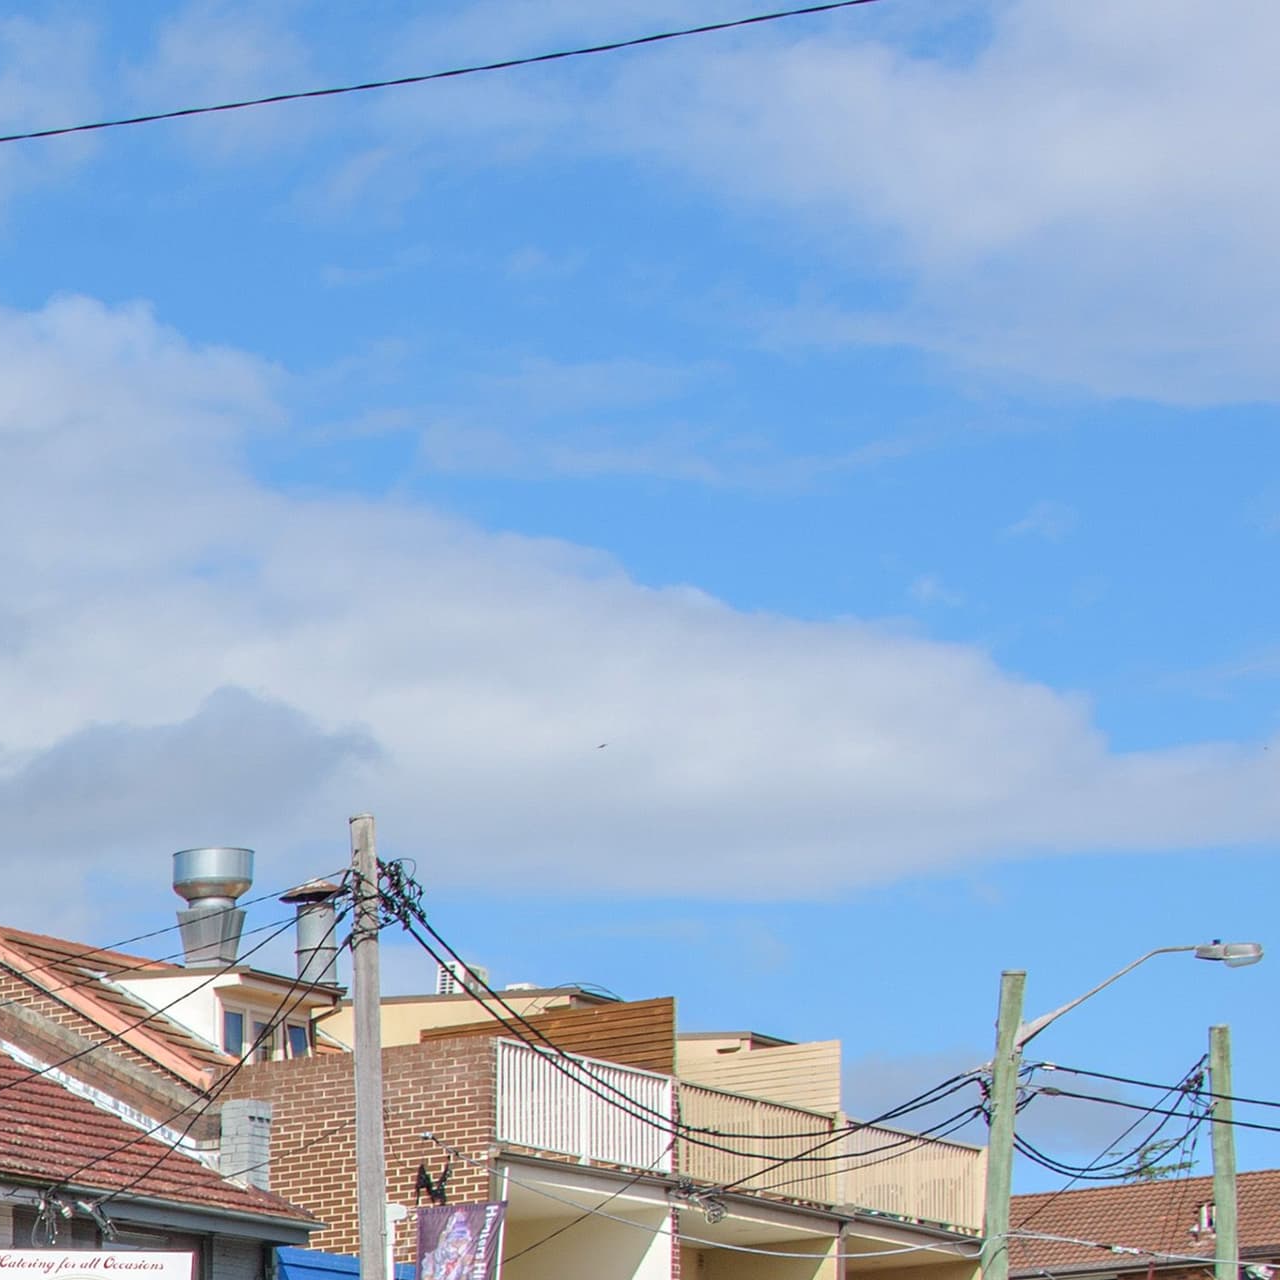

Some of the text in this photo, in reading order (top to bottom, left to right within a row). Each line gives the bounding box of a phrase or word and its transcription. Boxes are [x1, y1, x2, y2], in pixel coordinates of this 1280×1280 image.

[54, 1257, 75, 1274] for
[79, 1257, 102, 1269] all
[103, 1255, 164, 1270] Occasions
